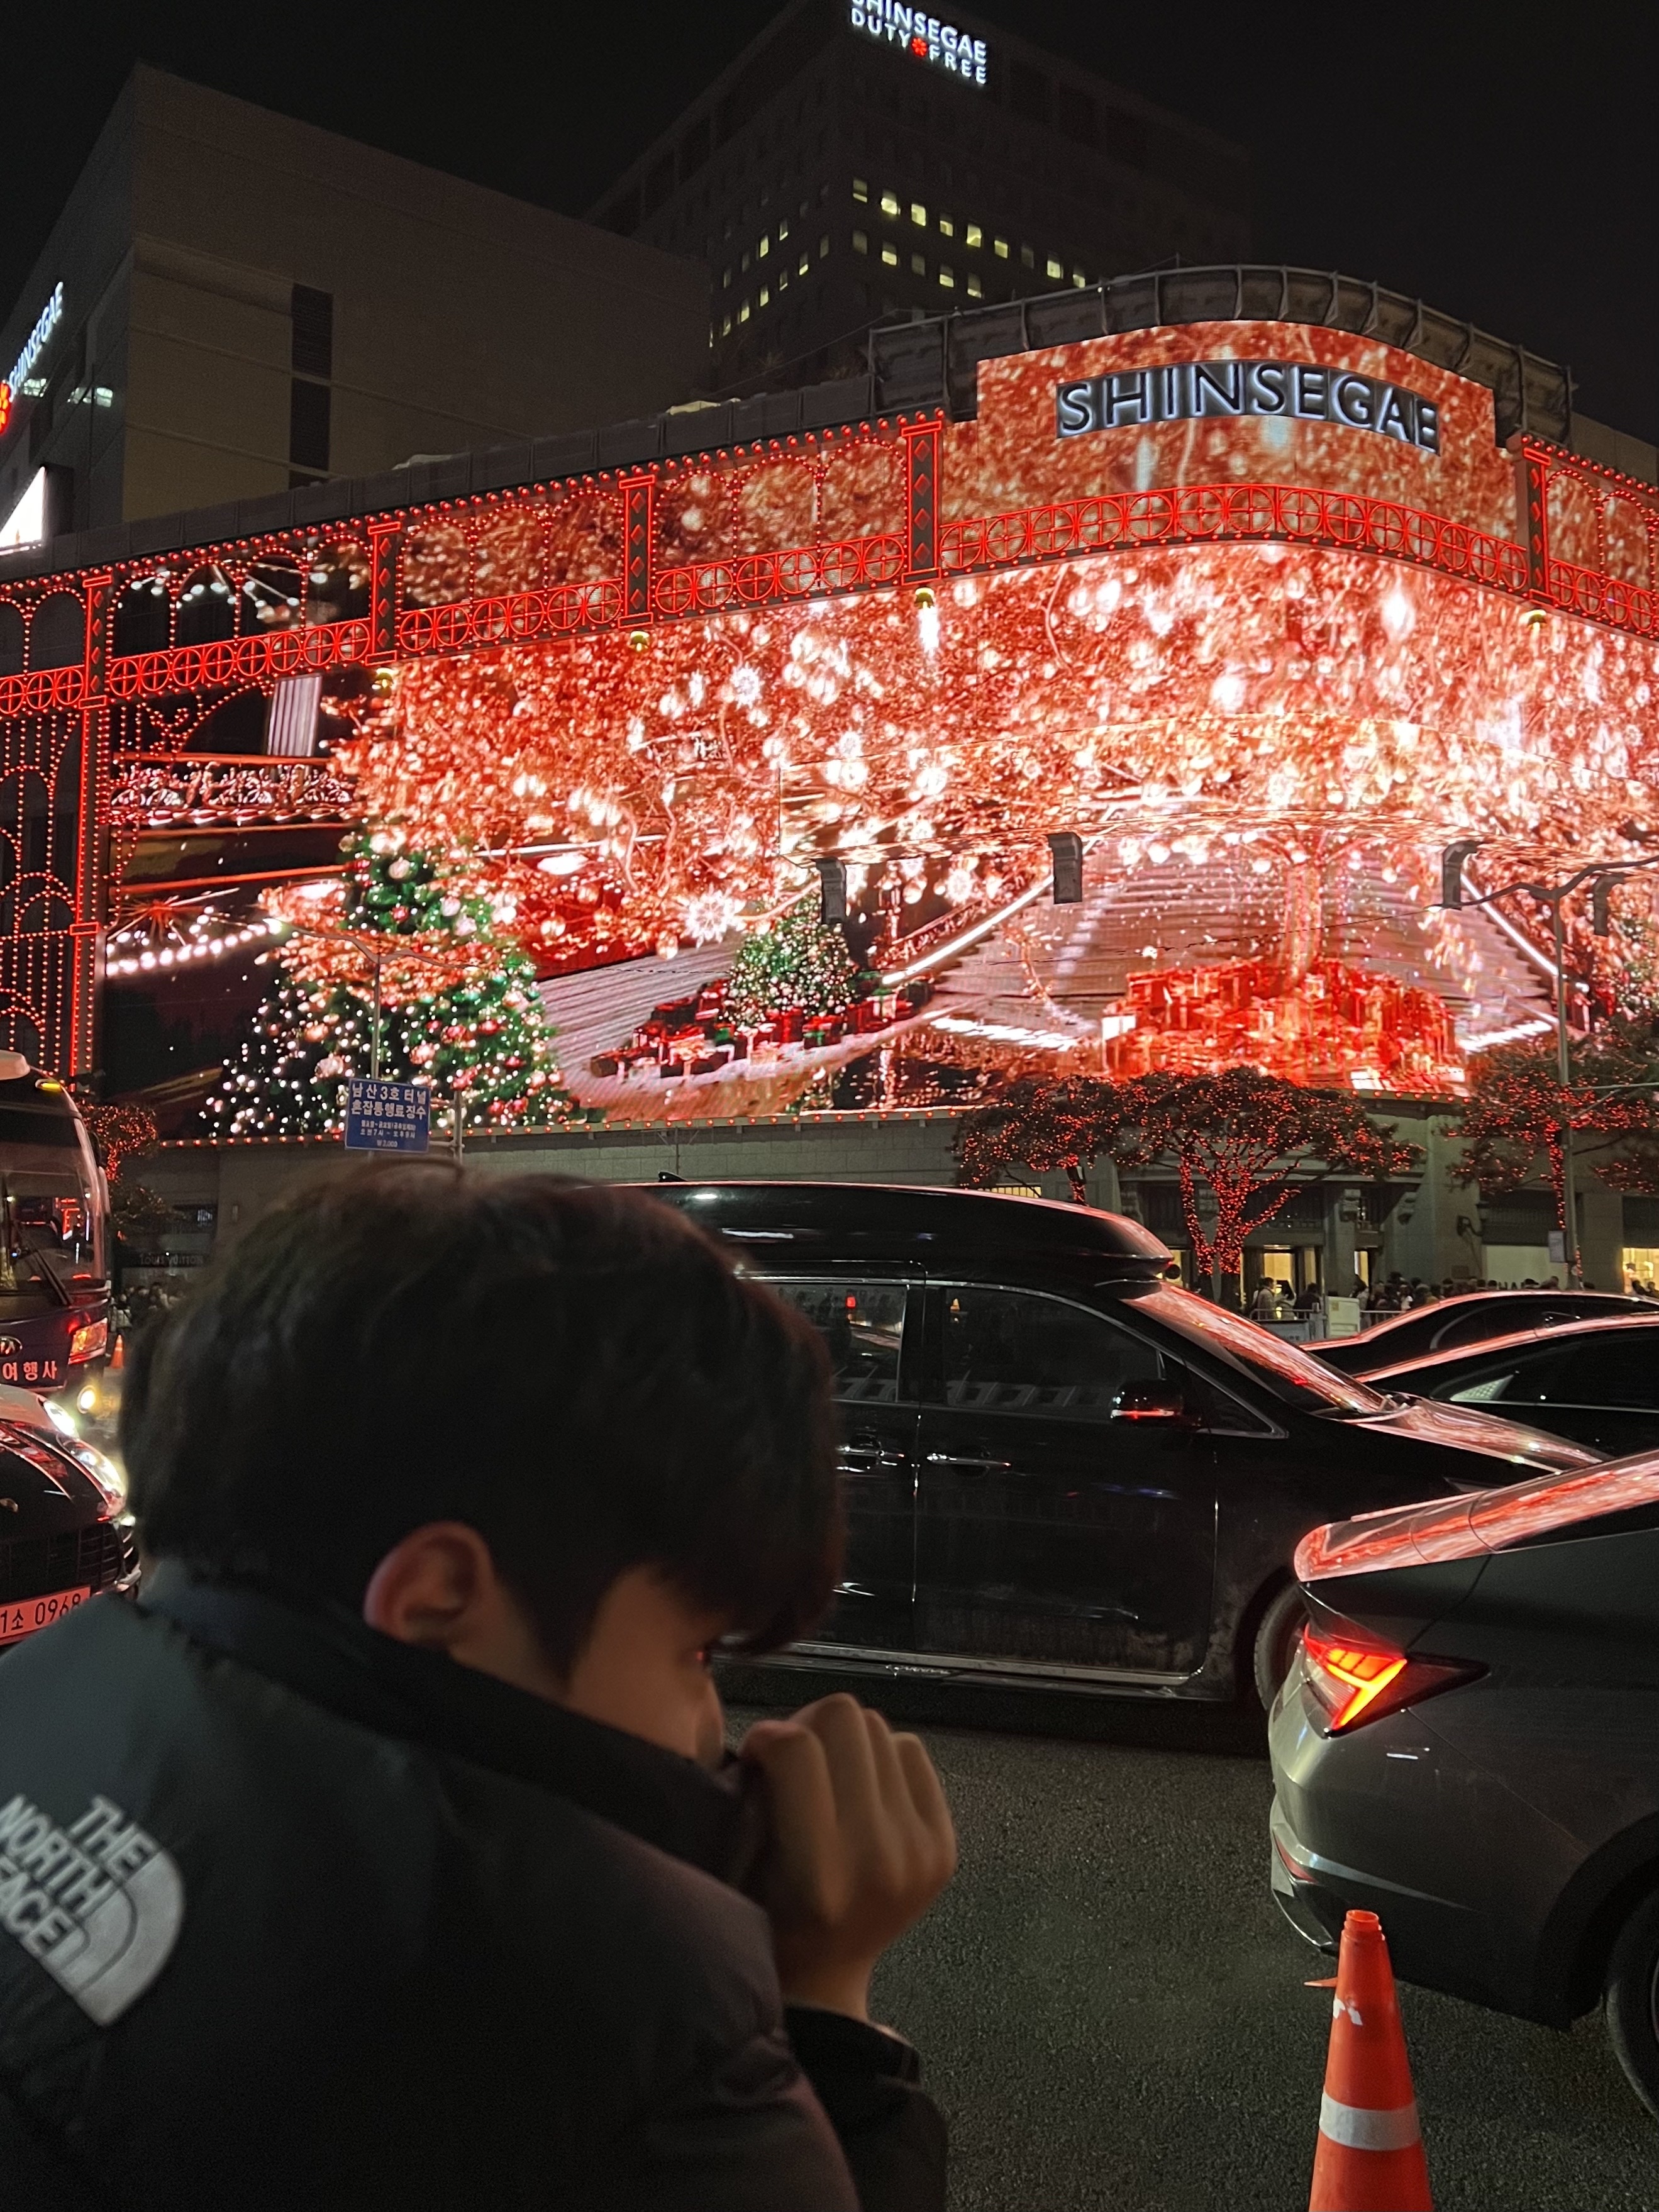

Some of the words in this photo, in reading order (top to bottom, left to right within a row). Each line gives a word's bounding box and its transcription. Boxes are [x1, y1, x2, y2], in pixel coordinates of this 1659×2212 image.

[851, 8, 911, 49] DUTY
[929, 44, 986, 84] FREE
[1059, 362, 1439, 454] SHINSEGAE
[351, 1099, 426, 1120] 혼잡통행료징수
[2, 1360, 58, 1381] 여행사
[68, 1794, 158, 1879] THE
